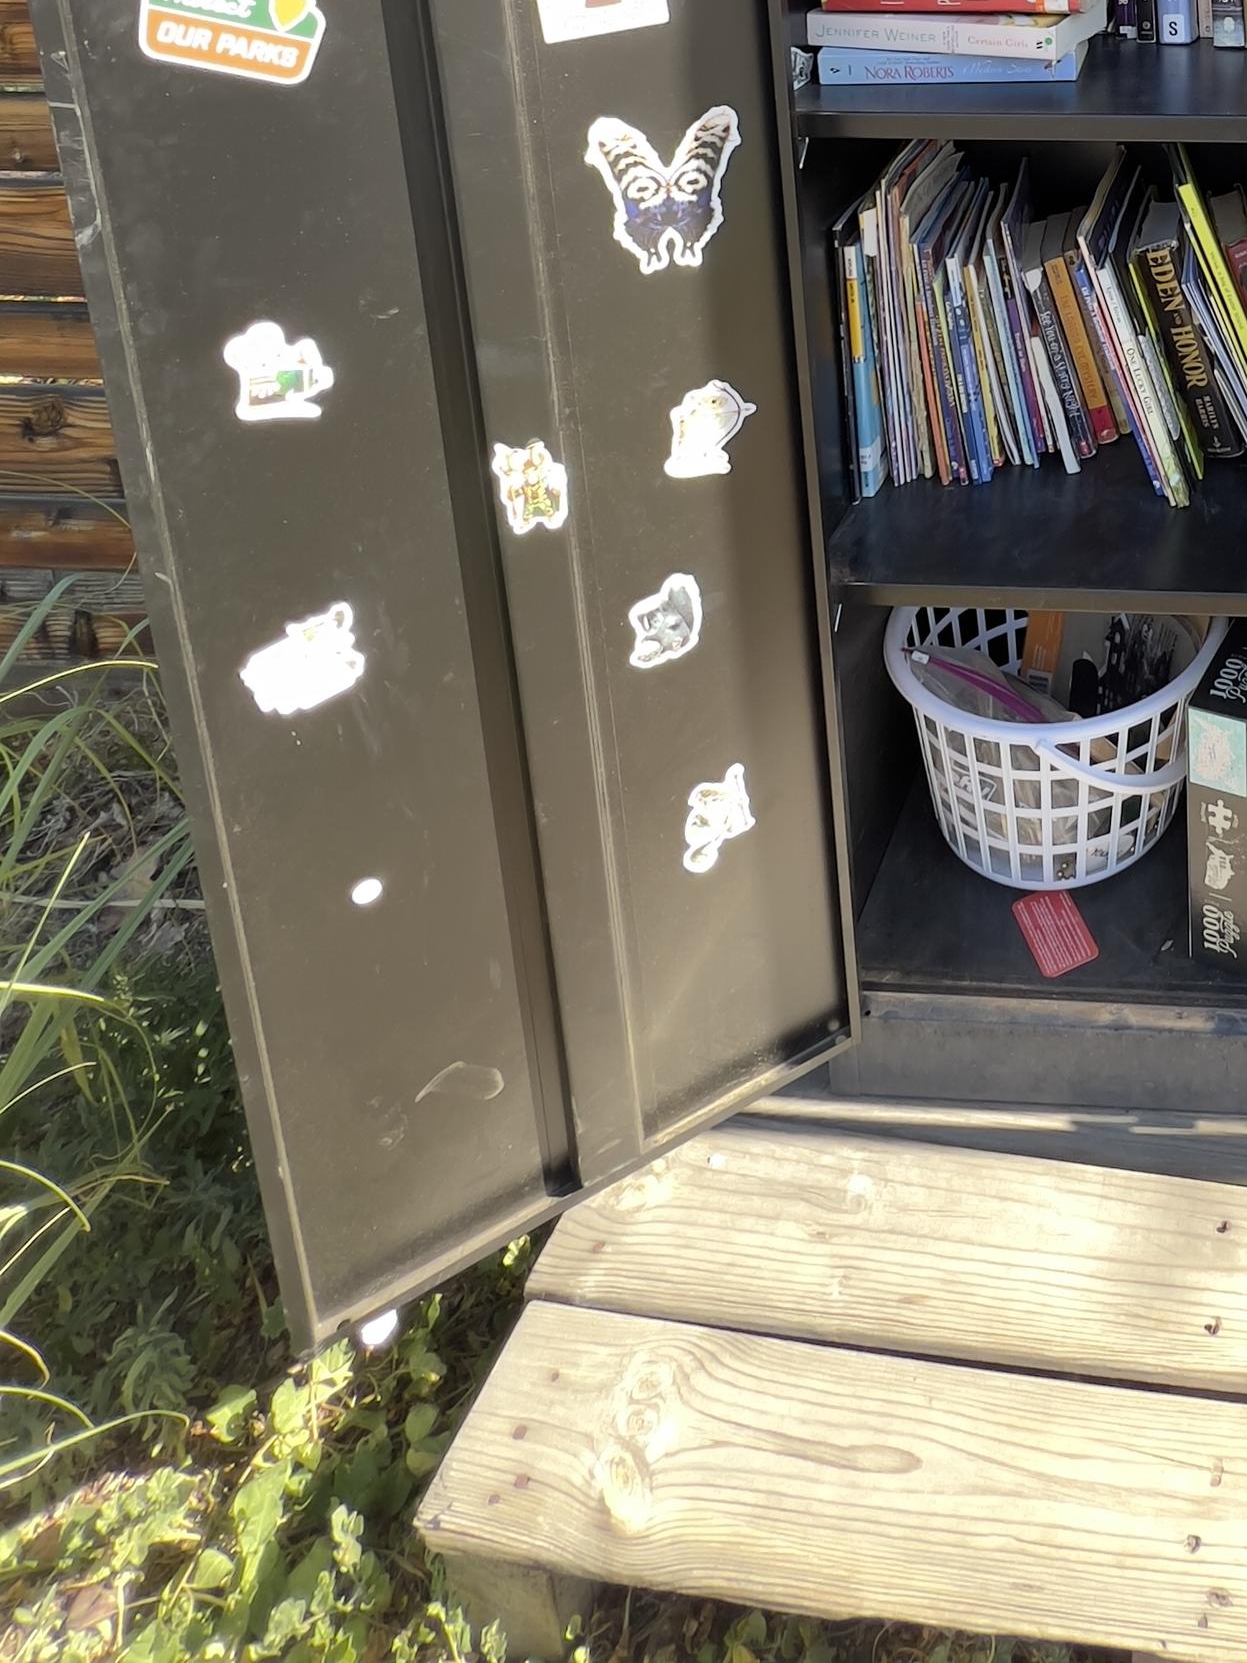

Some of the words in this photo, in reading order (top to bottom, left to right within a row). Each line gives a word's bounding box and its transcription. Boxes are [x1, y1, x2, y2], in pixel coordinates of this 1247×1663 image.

[157, 20, 212, 53] OUR
[216, 26, 299, 69] PARKS
[815, 24, 879, 40] JENNIFER
[884, 28, 937, 42] WEINER
[864, 65, 901, 79] NORA
[903, 65, 954, 79] ROBERTS
[1147, 249, 1185, 312] EDEN
[1171, 326, 1208, 389] HONOR
[1041, 311, 1050, 325] See
[1063, 389, 1081, 418] Night
[1126, 348, 1138, 365] ONE
[1133, 367, 1149, 396] LUCKY
[1210, 656, 1243, 698] 1000
[1202, 904, 1221, 951] 1000
